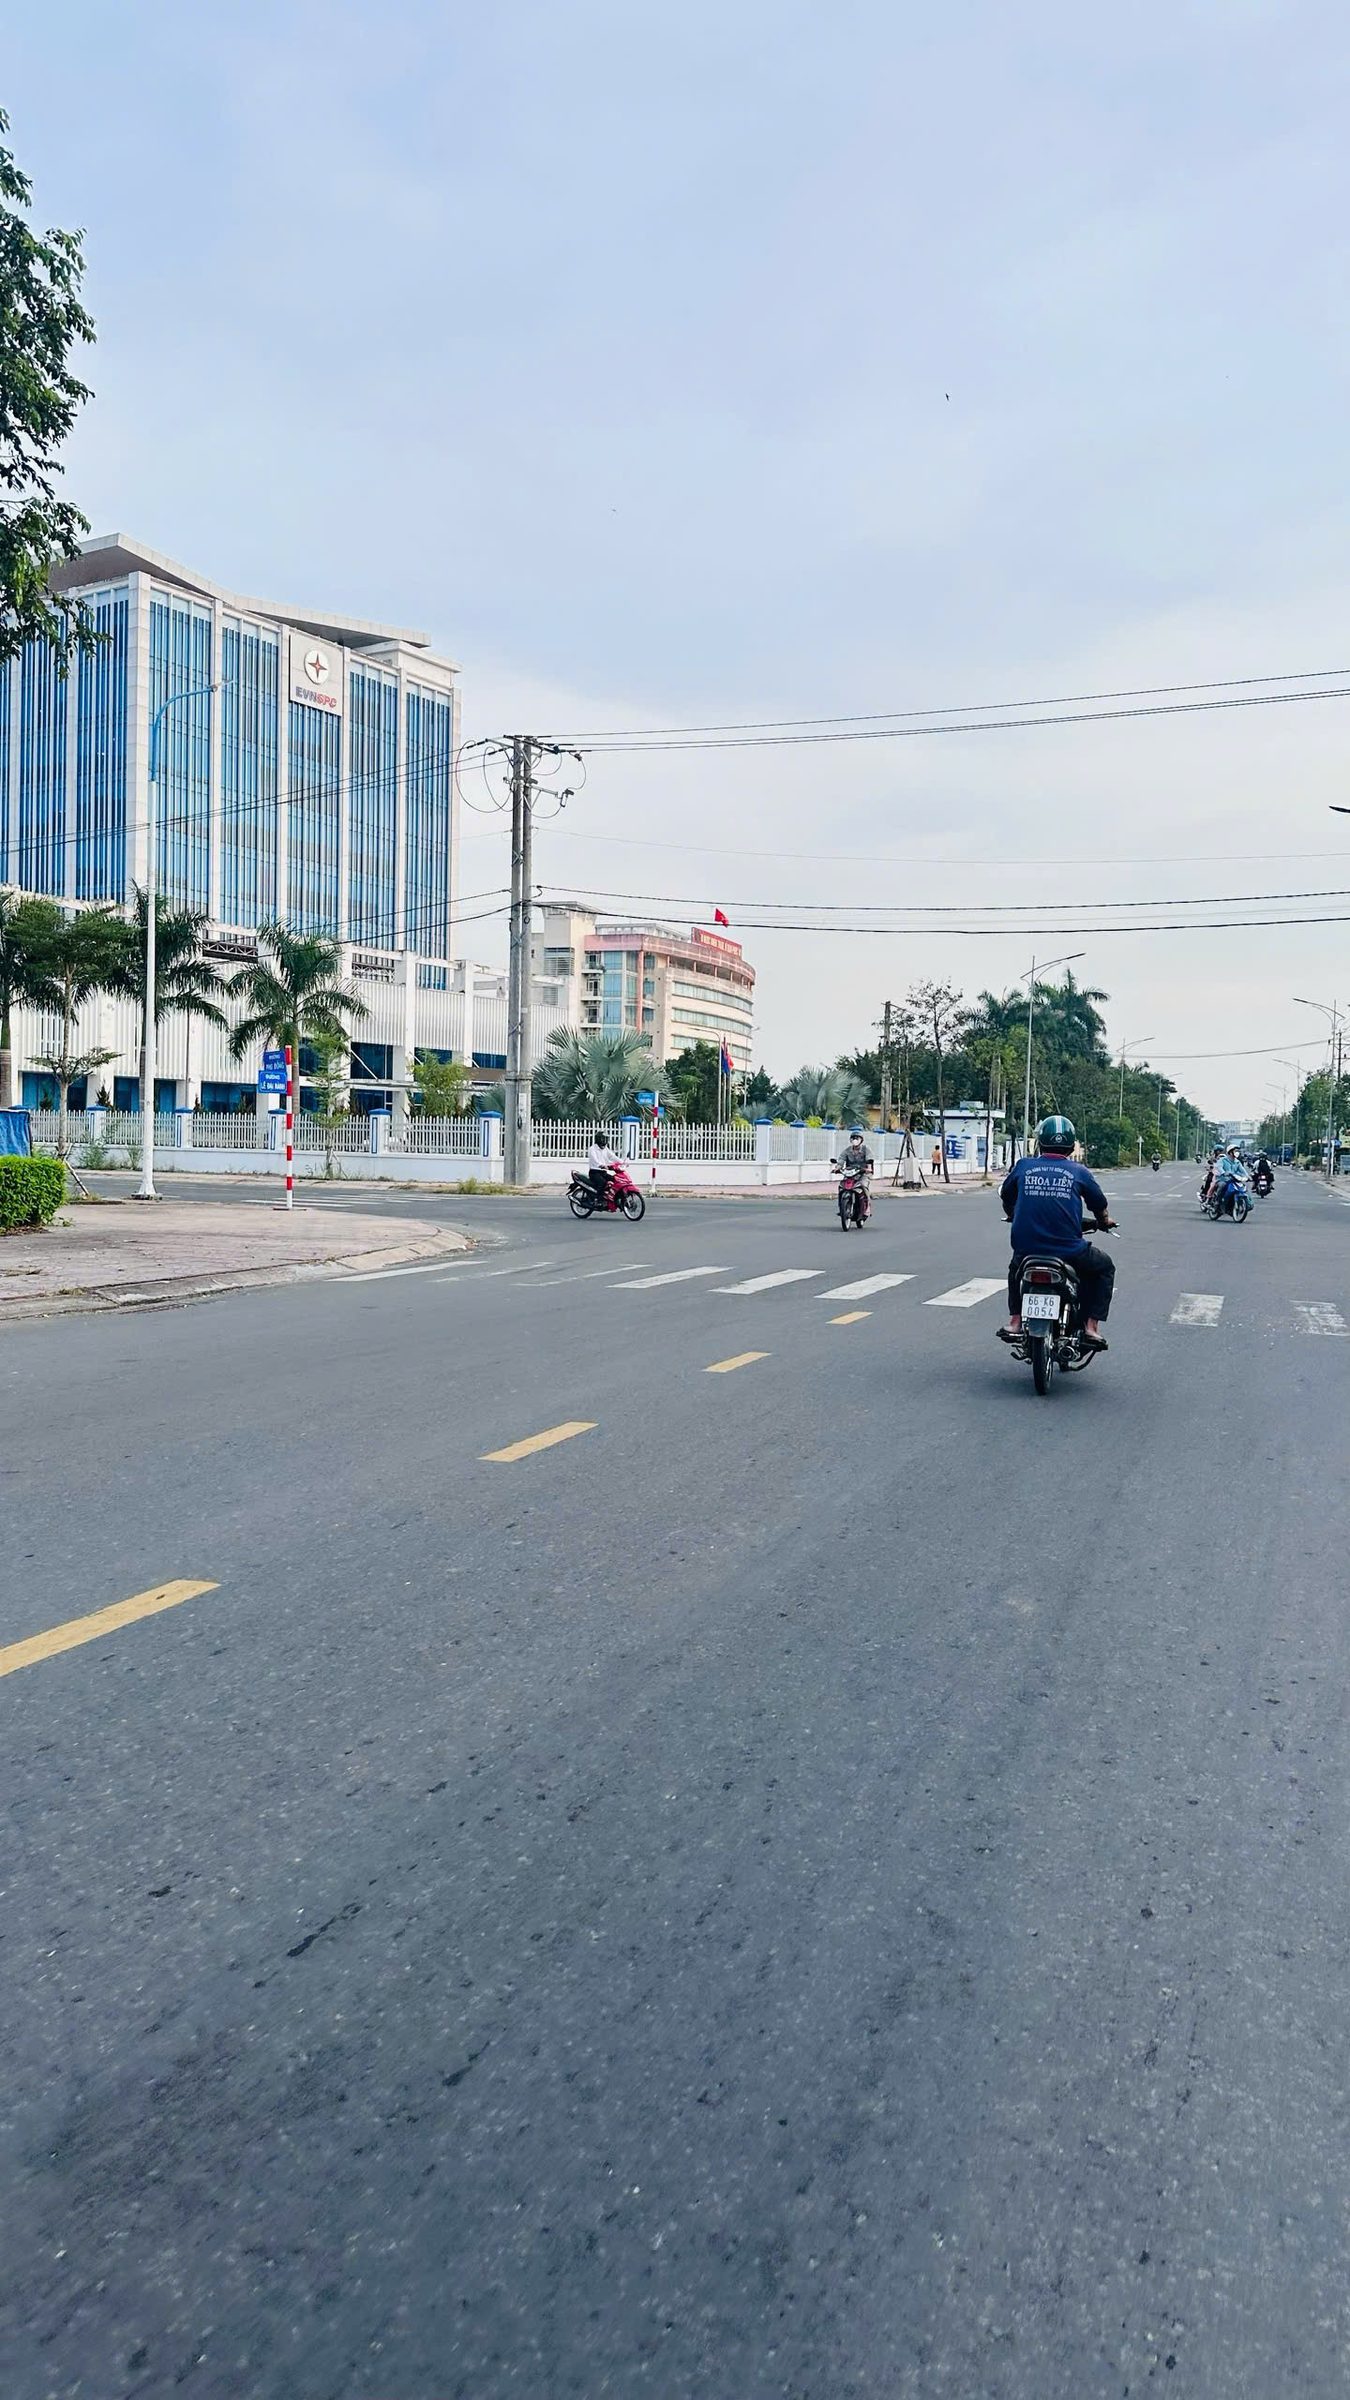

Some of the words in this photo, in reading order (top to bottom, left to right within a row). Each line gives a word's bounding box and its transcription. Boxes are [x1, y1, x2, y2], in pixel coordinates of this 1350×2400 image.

[295, 686, 337, 708] EVNSPC
[1024, 1175, 1051, 1186] KHOA
[1052, 1176, 1074, 1189] LIÊN
[1027, 1306, 1054, 1318] 0054
